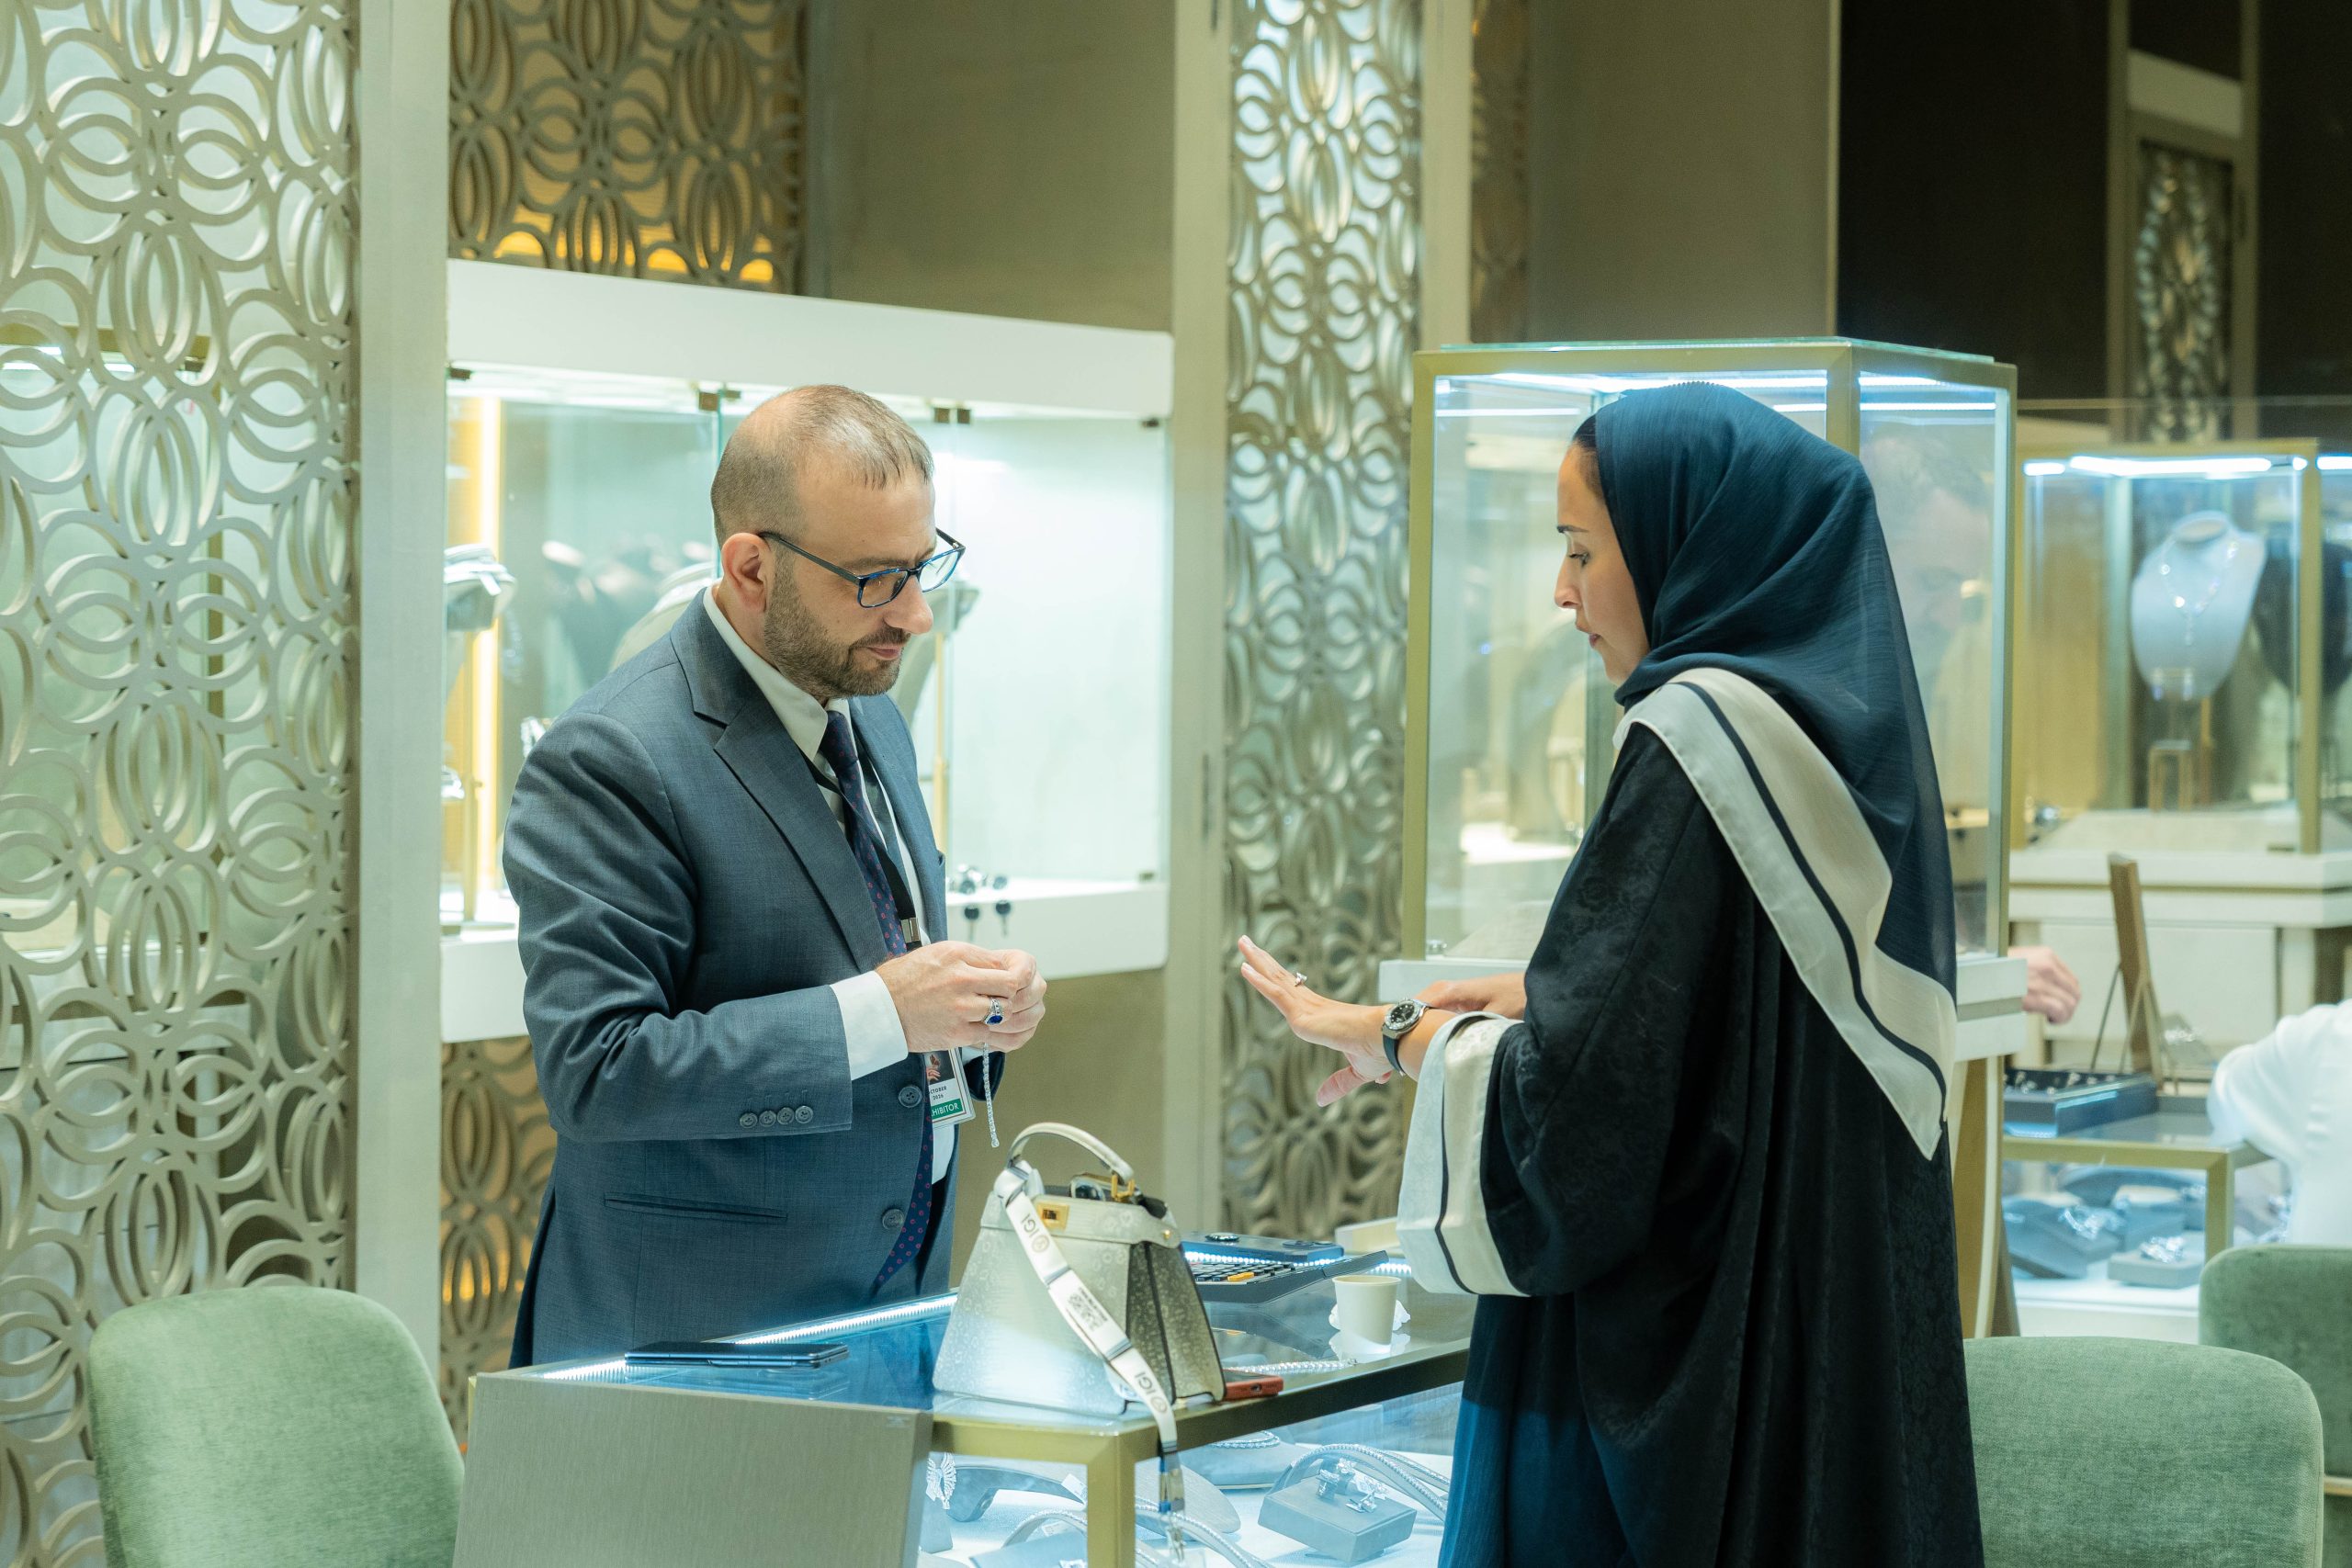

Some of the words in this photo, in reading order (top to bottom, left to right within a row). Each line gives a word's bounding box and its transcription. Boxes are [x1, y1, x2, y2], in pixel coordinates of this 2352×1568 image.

[930, 1085, 946, 1094] CTOBER
[932, 1103, 959, 1115] HIBITOR
[1021, 1213, 1039, 1238] IGI
[1134, 1371, 1157, 1394] IGI
